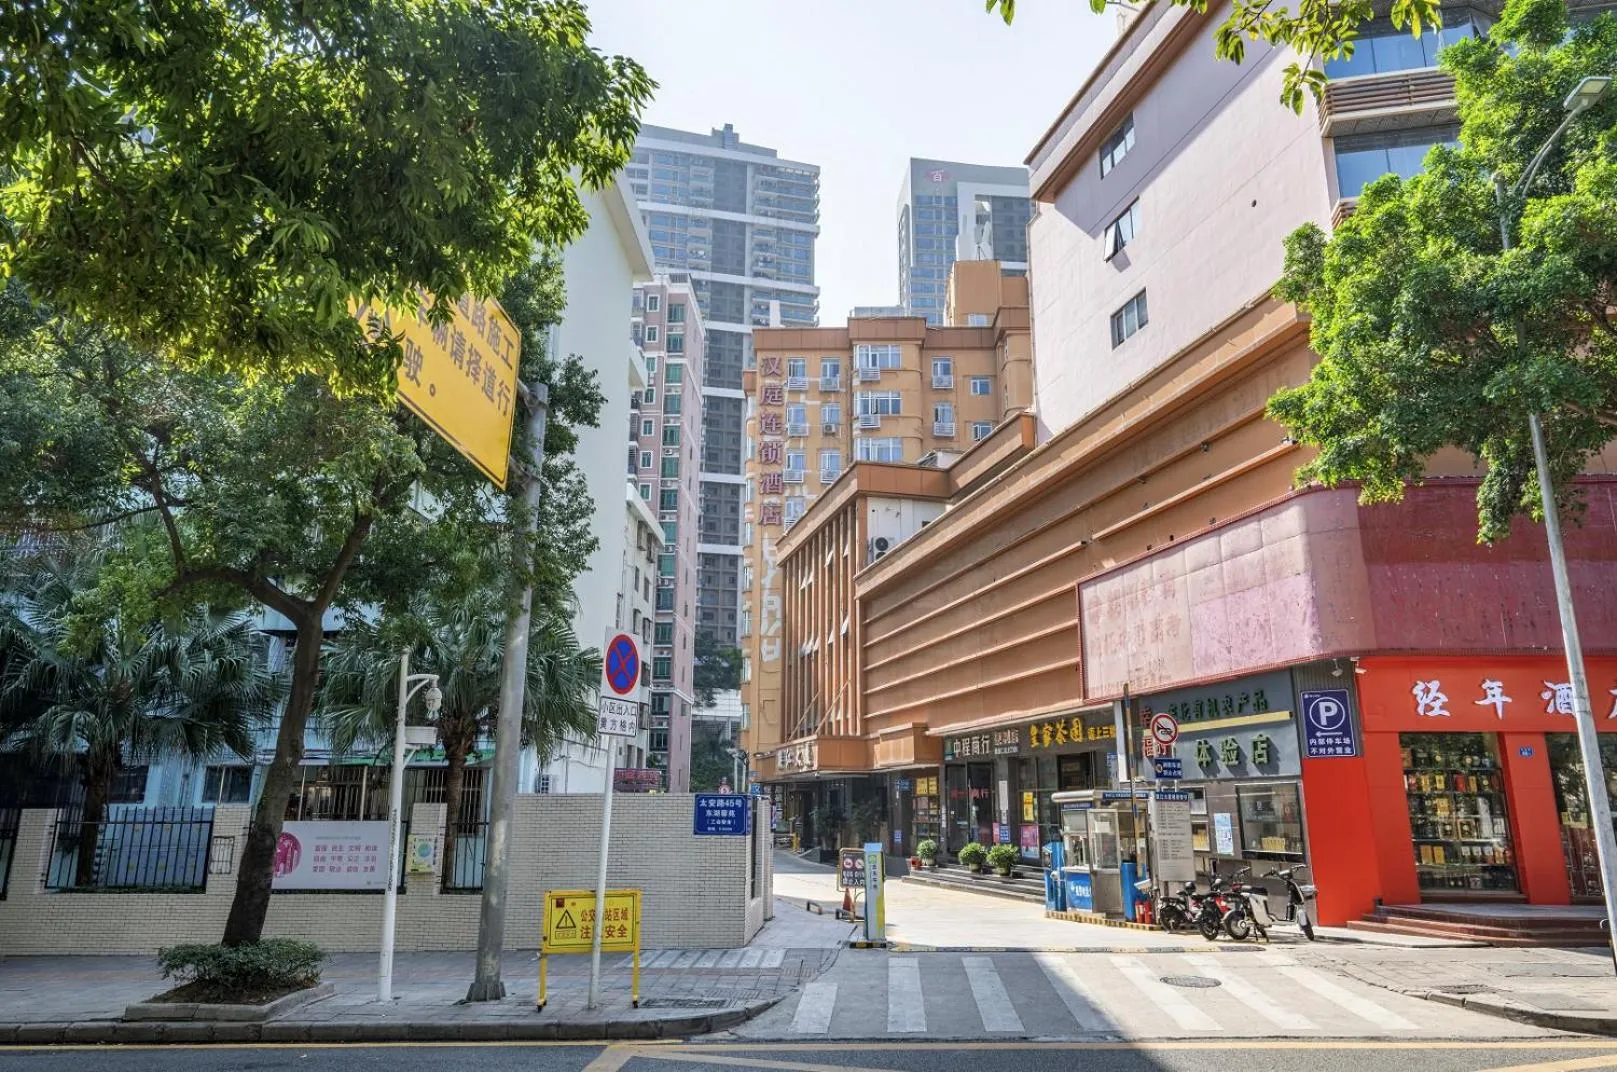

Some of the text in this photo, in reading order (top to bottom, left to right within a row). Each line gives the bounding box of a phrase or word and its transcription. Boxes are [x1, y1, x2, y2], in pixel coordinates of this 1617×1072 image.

[759, 356, 785, 526] 汉庭连锁酒店
[602, 701, 637, 716] 小区出入口
[1318, 701, 1338, 726] P
[1309, 737, 1351, 746] 内部停车场
[1197, 733, 1269, 768] 体验店
[580, 906, 629, 922] 公交站区域
[580, 923, 629, 939] 注安全
